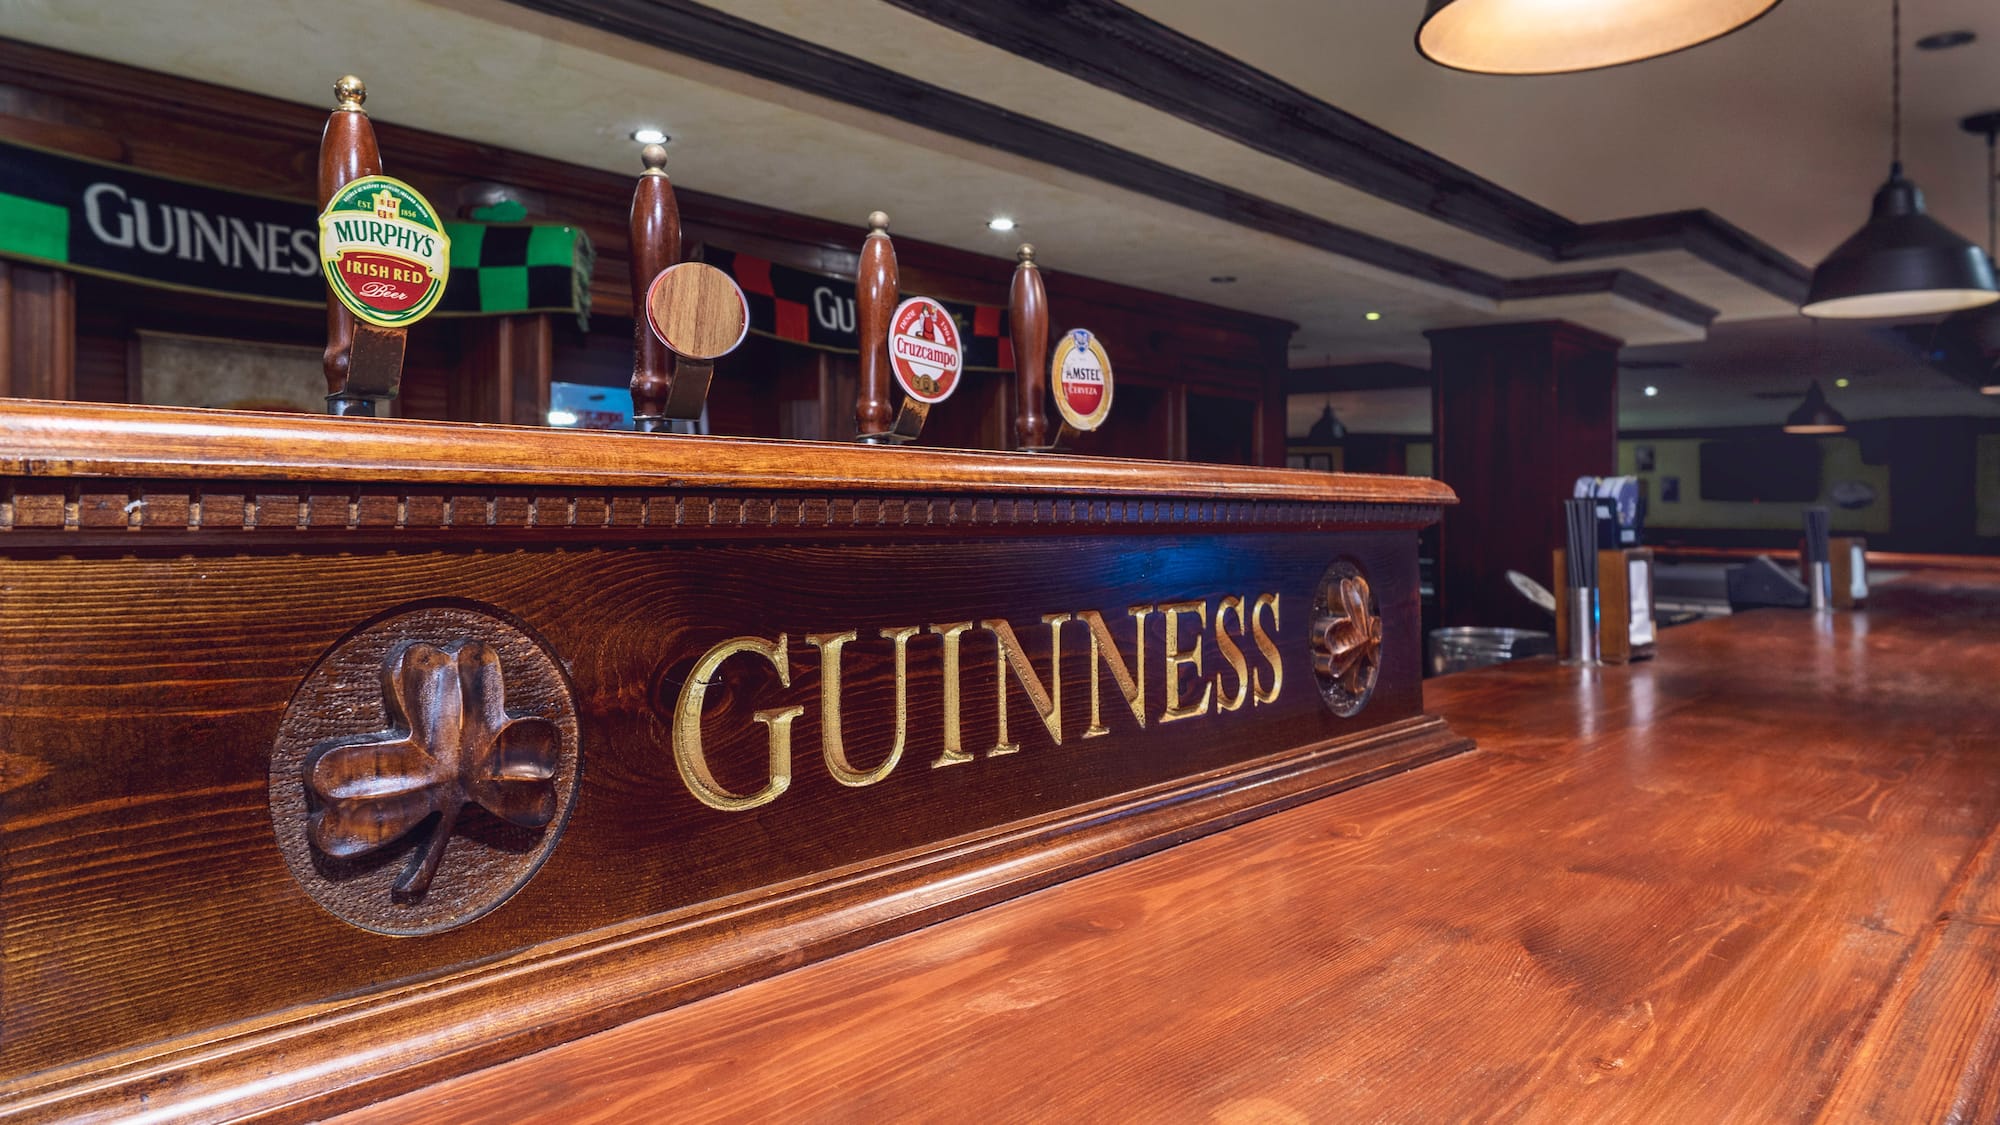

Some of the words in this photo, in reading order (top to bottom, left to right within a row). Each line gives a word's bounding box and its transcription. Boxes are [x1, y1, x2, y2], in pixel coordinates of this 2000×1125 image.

[83, 182, 323, 277] GUINNES
[334, 220, 435, 258] MURPHY'S
[346, 260, 389, 279] IRISH
[393, 269, 424, 284] RED
[359, 282, 408, 301] Beer
[897, 337, 957, 367] Cruzcampo
[1066, 367, 1101, 381] AMSTEL
[672, 592, 1284, 813] GUINNESS
